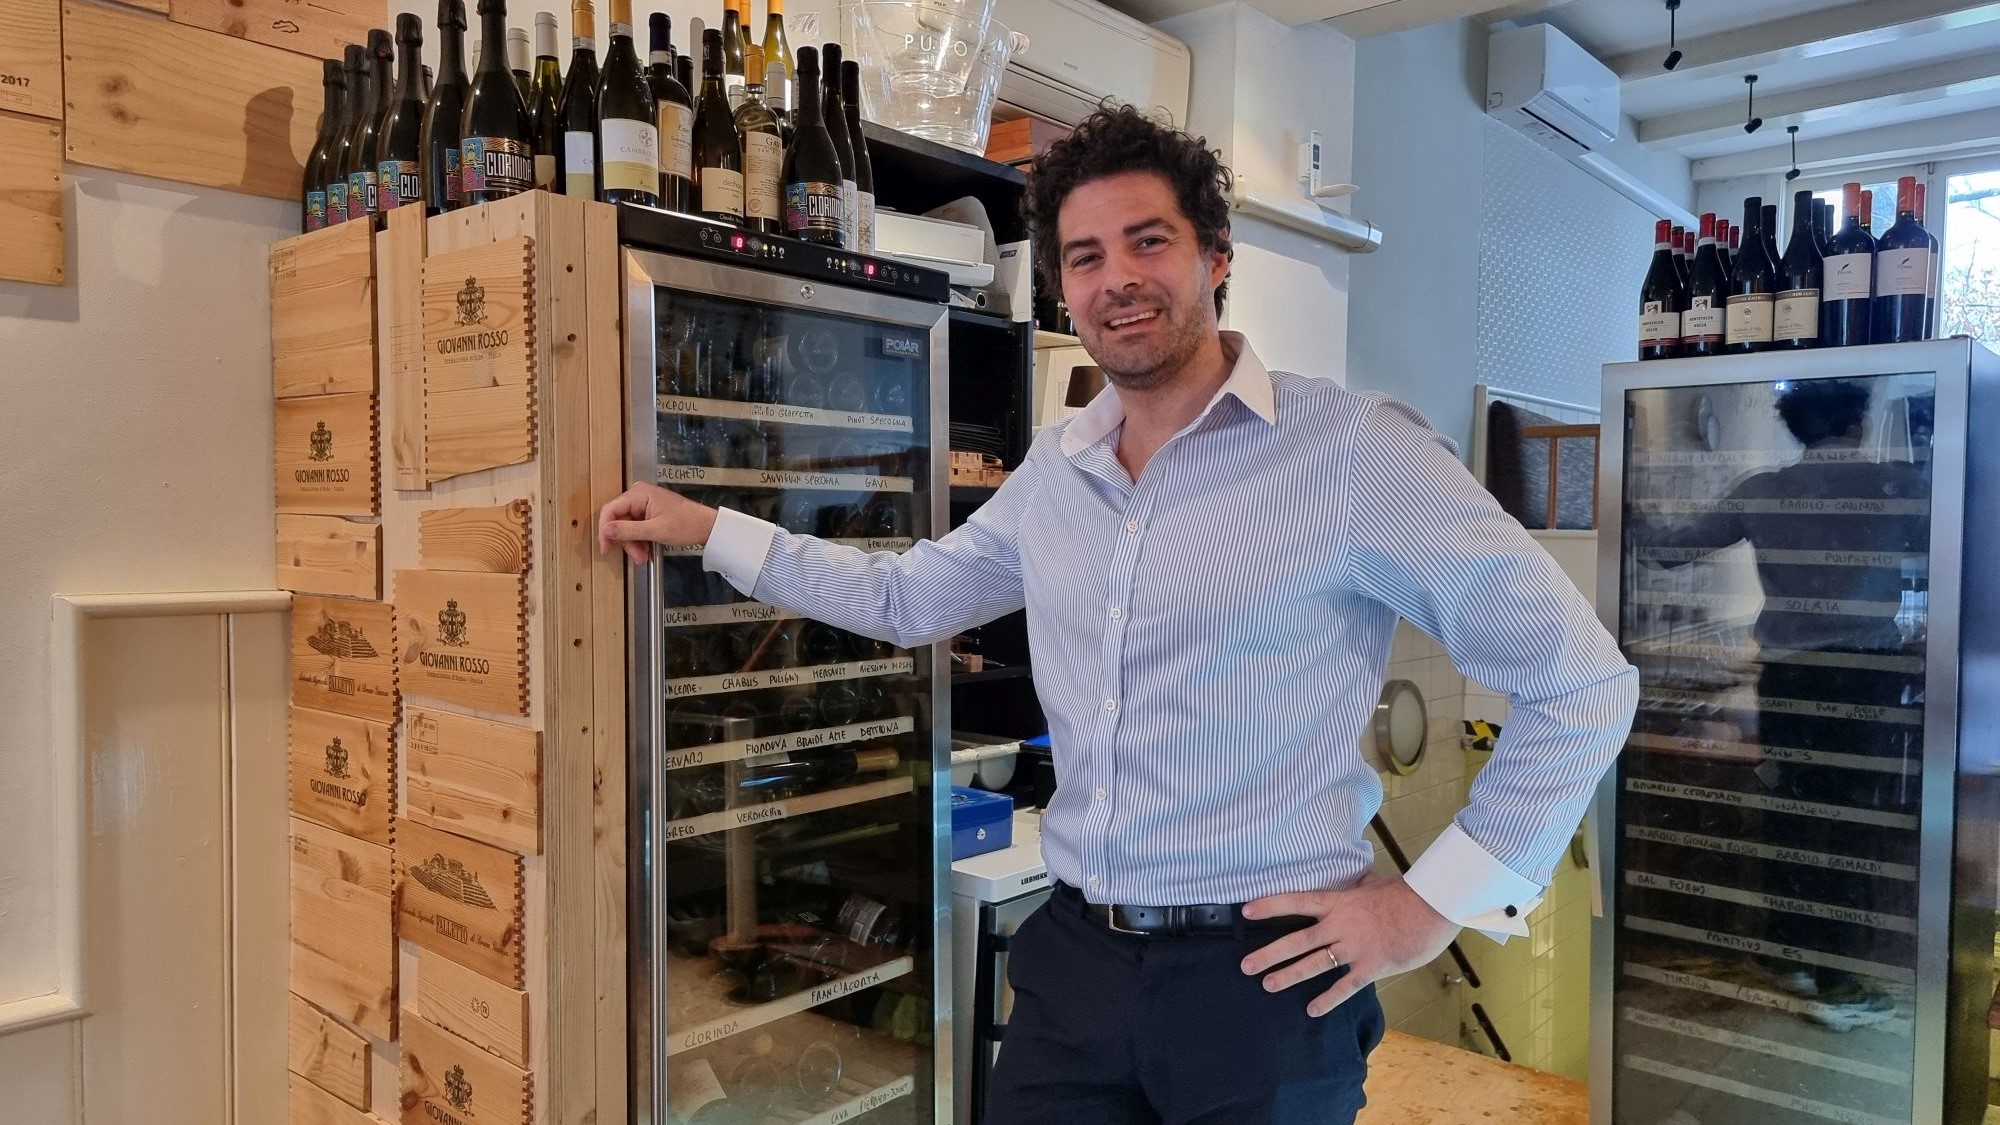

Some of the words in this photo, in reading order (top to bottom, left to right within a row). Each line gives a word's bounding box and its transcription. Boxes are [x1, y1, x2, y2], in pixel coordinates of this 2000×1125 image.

[0, 74, 31, 88] 2017
[486, 151, 533, 183] CLORINDA
[808, 194, 842, 220] CLORIND
[437, 334, 477, 355] GIOVANNI
[478, 329, 509, 350] ROSSO
[847, 415, 866, 424] PINOT
[294, 469, 325, 484] GIOVANNI
[326, 468, 350, 483] ROSSO
[864, 477, 888, 489] GAVI
[664, 612, 698, 624] UGENIO
[419, 651, 458, 671] GIOVANNI
[459, 656, 490, 675] ROSSO
[665, 750, 704, 769] ERVARO
[310, 778, 341, 800] GIOVANNI
[342, 787, 367, 807] ROSSO
[736, 807, 783, 824] VERDICCHIO
[1637, 874, 1656, 885] DAL
[1782, 947, 1803, 960] ES
[684, 1020, 740, 1048] CLORINDA
[811, 971, 881, 1003] FRANCIACORTA
[424, 1100, 463, 1125] GIOVANN
